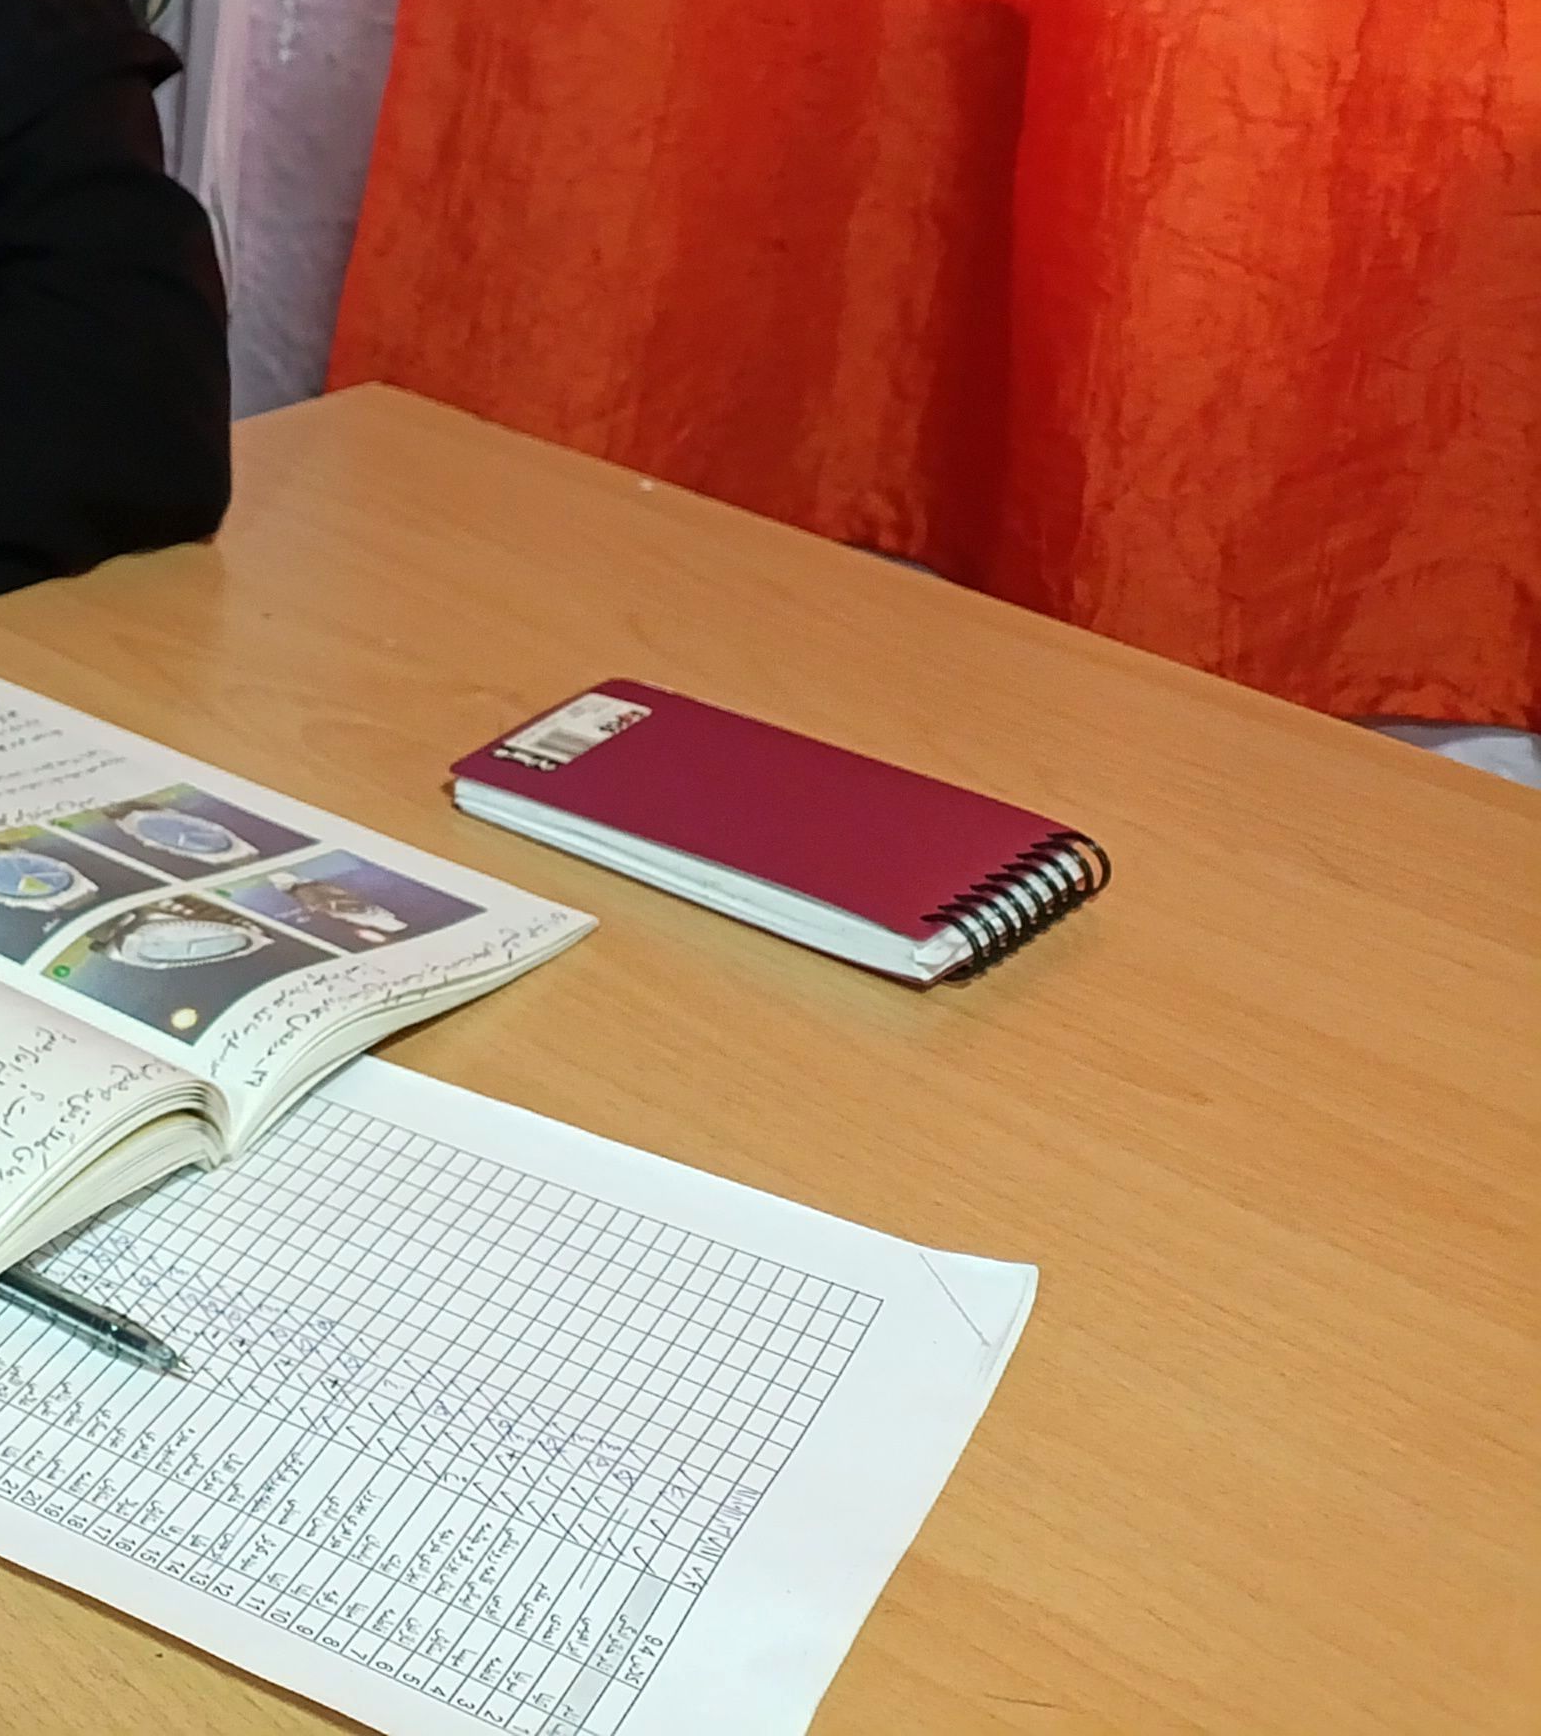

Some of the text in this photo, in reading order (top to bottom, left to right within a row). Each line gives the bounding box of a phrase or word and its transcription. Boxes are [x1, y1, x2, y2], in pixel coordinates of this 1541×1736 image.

[19, 1488, 43, 1507] 20
[42, 1501, 64, 1518] 19
[67, 1470, 92, 1493] فاطمه
[65, 1513, 88, 1529] 18
[90, 1476, 117, 1503] ستایش
[91, 1524, 112, 1541] 17
[113, 1498, 166, 1552] 16 ستایش
[138, 1547, 161, 1564] 15
[244, 1595, 266, 1611] 11
[304, 1515, 320, 1538] حسن
[163, 1559, 186, 1575] 14
[188, 1570, 211, 1586] 13
[211, 1581, 234, 1597] 12
[268, 1607, 292, 1624] 10
[294, 1623, 314, 1636] 9
[314, 1588, 339, 1608] رقیه
[320, 1635, 340, 1648] 8
[349, 1647, 368, 1661] 7
[370, 1607, 396, 1633] فاطمه
[401, 1671, 421, 1686] 5
[423, 1626, 450, 1656] ستایش
[374, 1660, 394, 1673] 6
[622, 1653, 645, 1685] کلاس
[428, 1684, 446, 1698] 4
[455, 1697, 476, 1710] 3
[477, 1655, 502, 1682] فاطمه
[482, 1708, 504, 1723] 2
